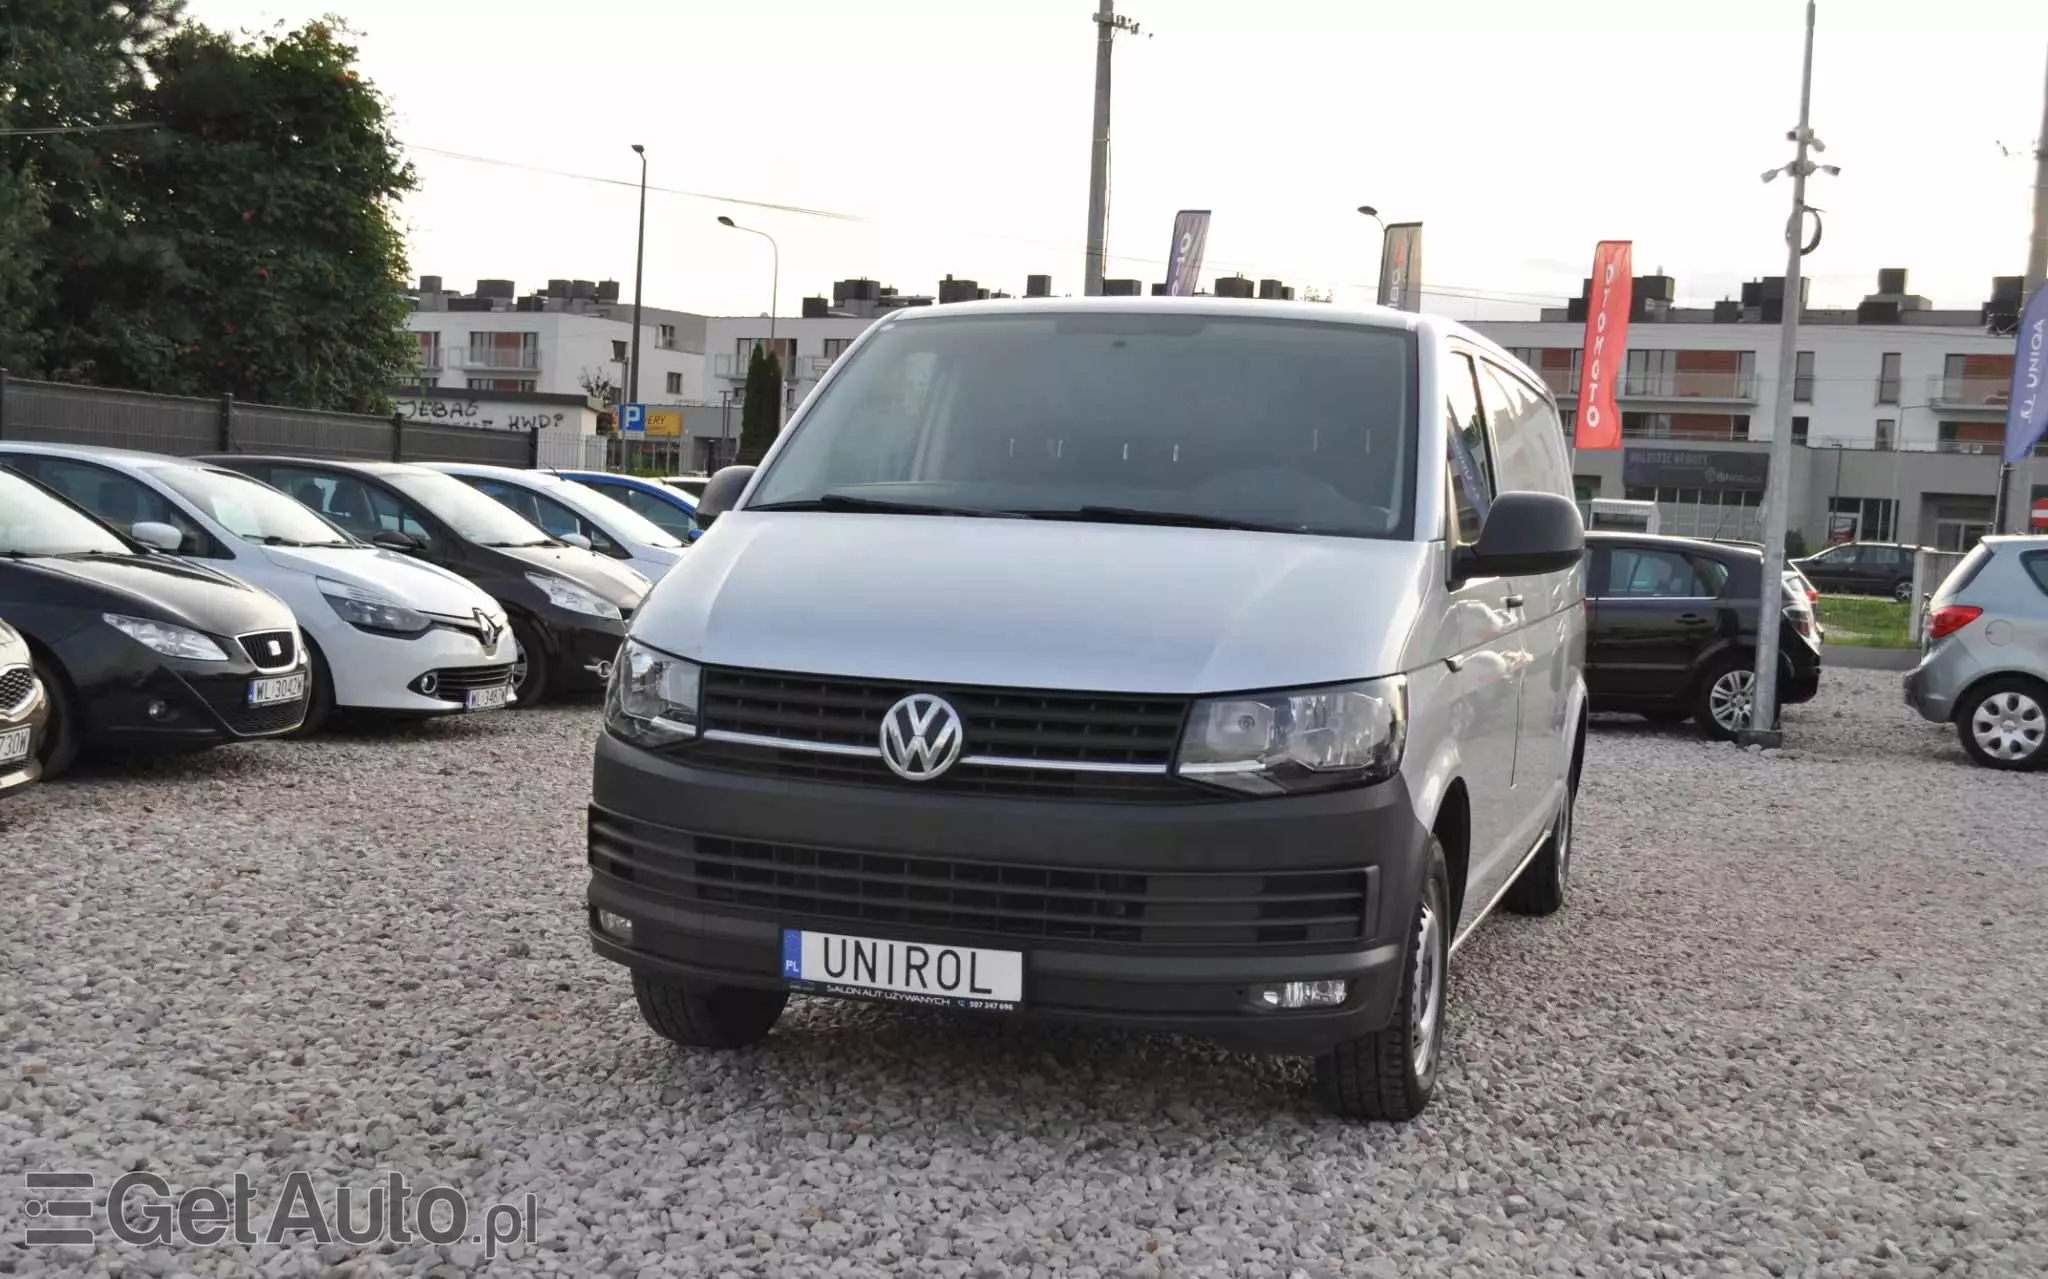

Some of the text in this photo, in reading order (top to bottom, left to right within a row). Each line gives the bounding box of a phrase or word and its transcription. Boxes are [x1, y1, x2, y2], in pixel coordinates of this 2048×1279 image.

[1586, 263, 1616, 428] OTOMOTO
[2026, 319, 2046, 389] UNIQA
[625, 406, 641, 428] P
[784, 959, 800, 973] PL
[824, 936, 993, 995] UNIROL
